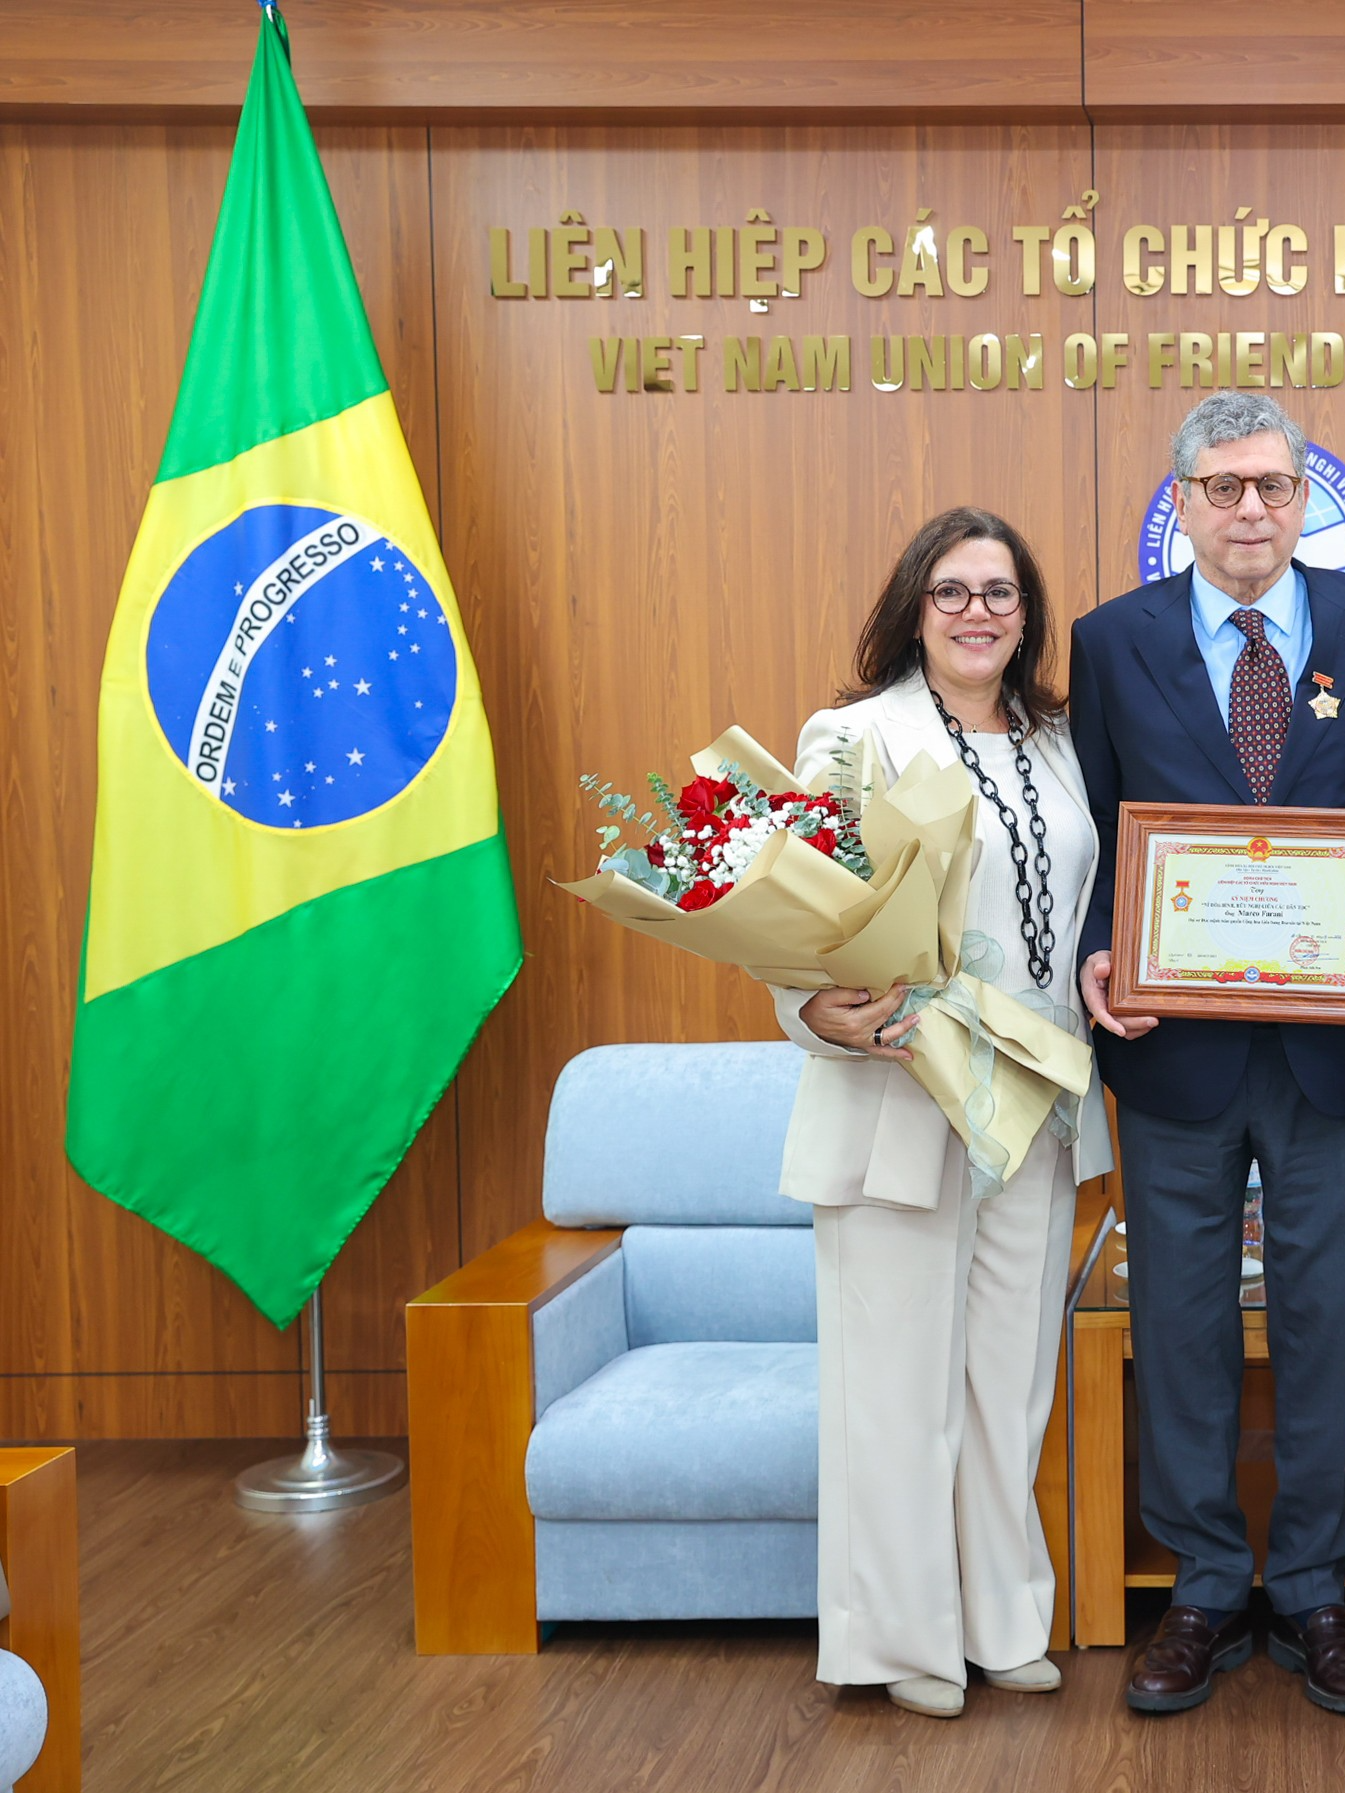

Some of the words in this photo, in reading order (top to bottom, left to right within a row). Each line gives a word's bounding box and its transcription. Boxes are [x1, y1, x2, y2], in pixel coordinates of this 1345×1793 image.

[489, 209, 643, 298] LIÊN
[668, 208, 827, 313] HIỆP
[851, 208, 989, 298] CÁC
[1013, 189, 1100, 297] TỔ
[1123, 207, 1308, 296] CHỨC
[589, 335, 704, 393] VIET
[723, 335, 851, 392] NAM
[870, 333, 1044, 393] UNION
[1063, 332, 1129, 390] OF
[1306, 452, 1342, 485] NGHỊ
[1146, 512, 1167, 548] LIÊN
[234, 523, 360, 656] PROGRESSO
[228, 658, 243, 678] E
[196, 681, 237, 783] ORDEM
[1238, 909, 1260, 918] Marco
